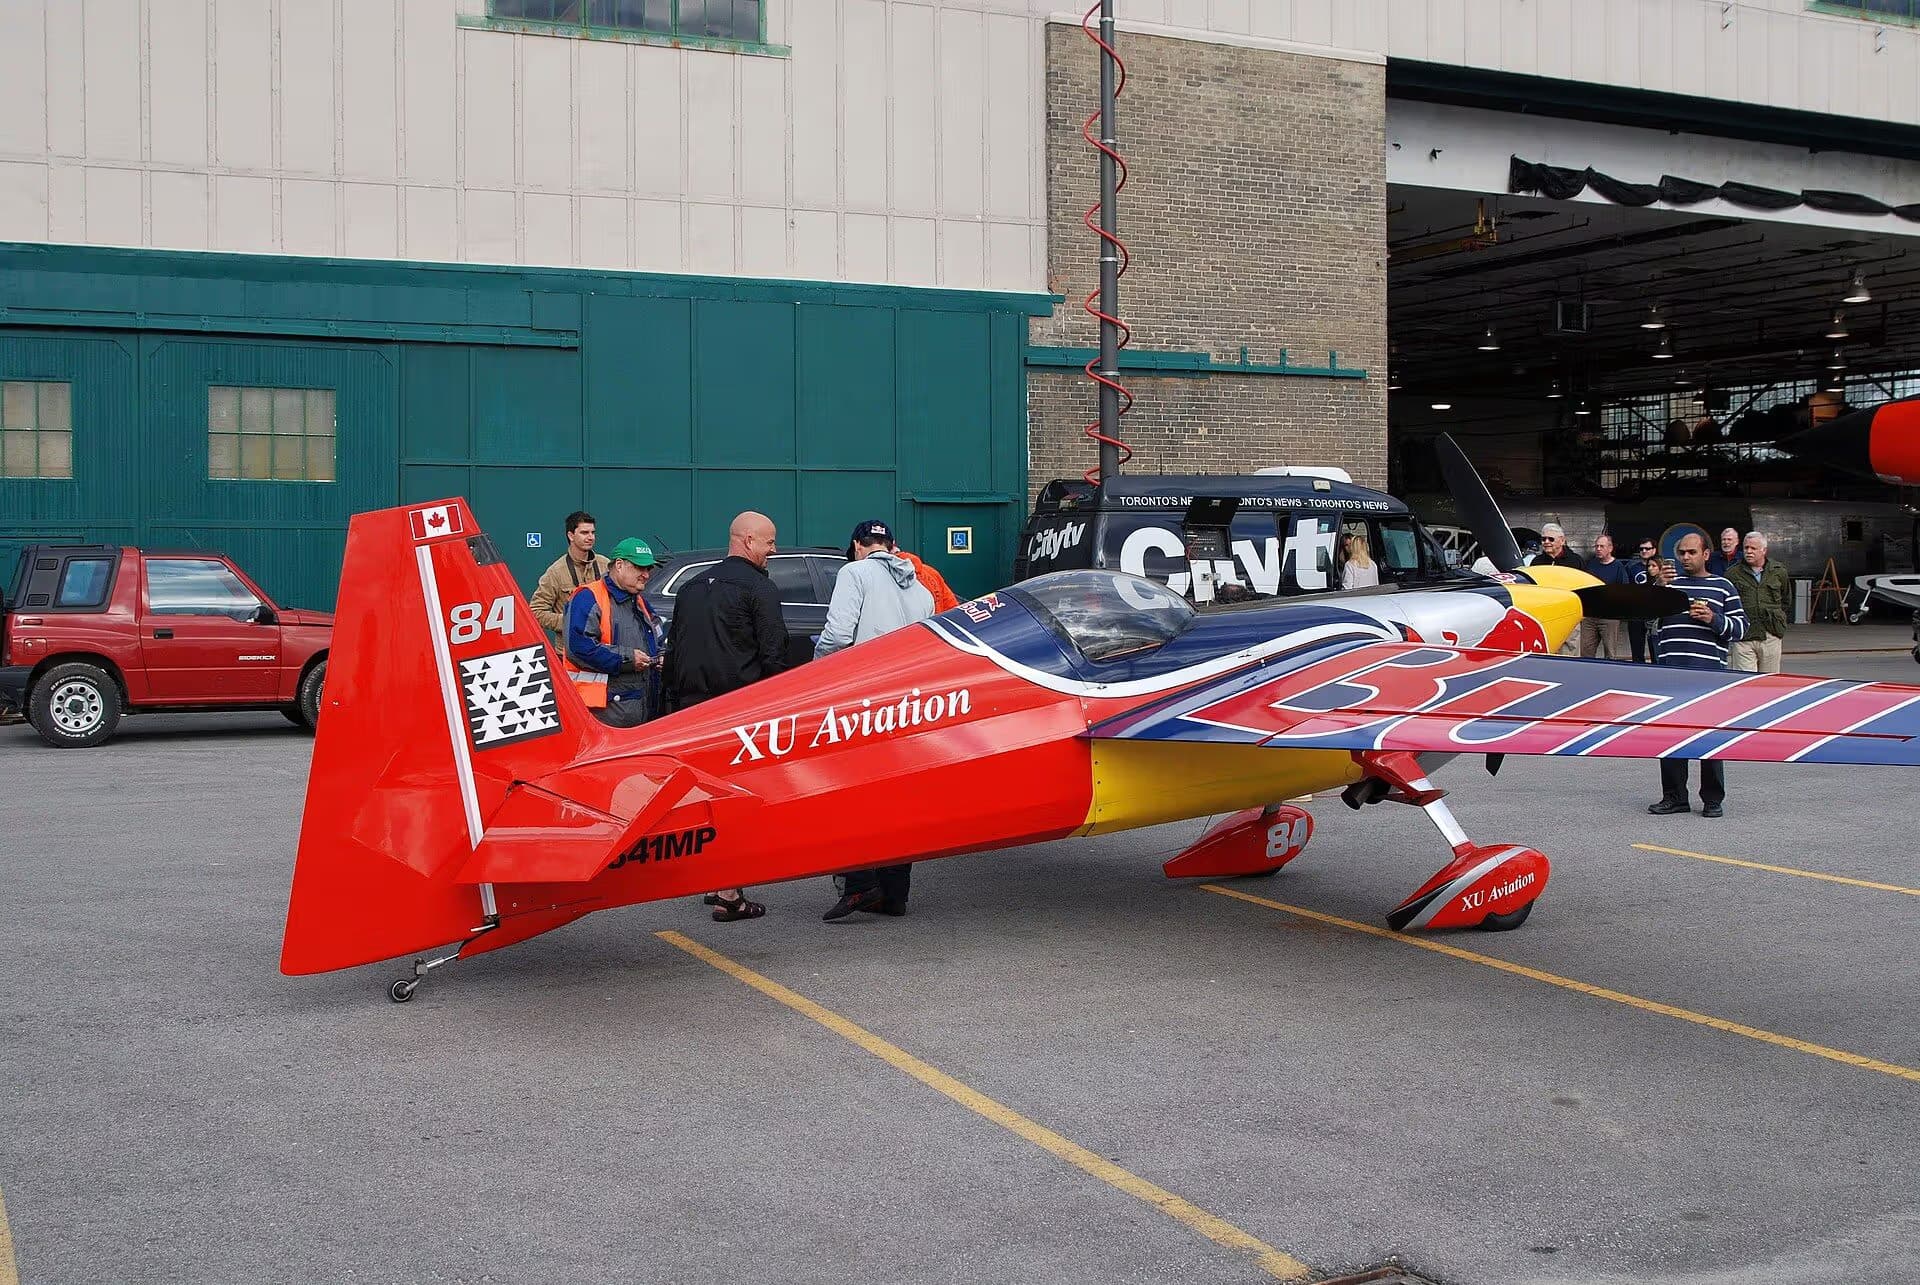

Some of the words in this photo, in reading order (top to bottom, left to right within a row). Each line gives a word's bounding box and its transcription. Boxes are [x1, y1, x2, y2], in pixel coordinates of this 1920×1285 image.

[1119, 496, 1178, 506] TORONTO'S
[1180, 496, 1194, 506] NE
[1238, 497, 1273, 507] ONTO'S
[1274, 498, 1302, 507] NEWS
[1308, 498, 1361, 509] TORONTO'S
[1362, 501, 1389, 510] NEWS
[1027, 521, 1086, 562] Citytv
[1120, 518, 1337, 602] Ciyt
[449, 594, 515, 645] 84
[957, 600, 993, 623] Bull
[730, 714, 800, 765] XU
[809, 688, 972, 748] Aviation
[1266, 815, 1308, 858] 84
[1461, 890, 1485, 912] XU
[1488, 872, 1535, 903] Aviation
